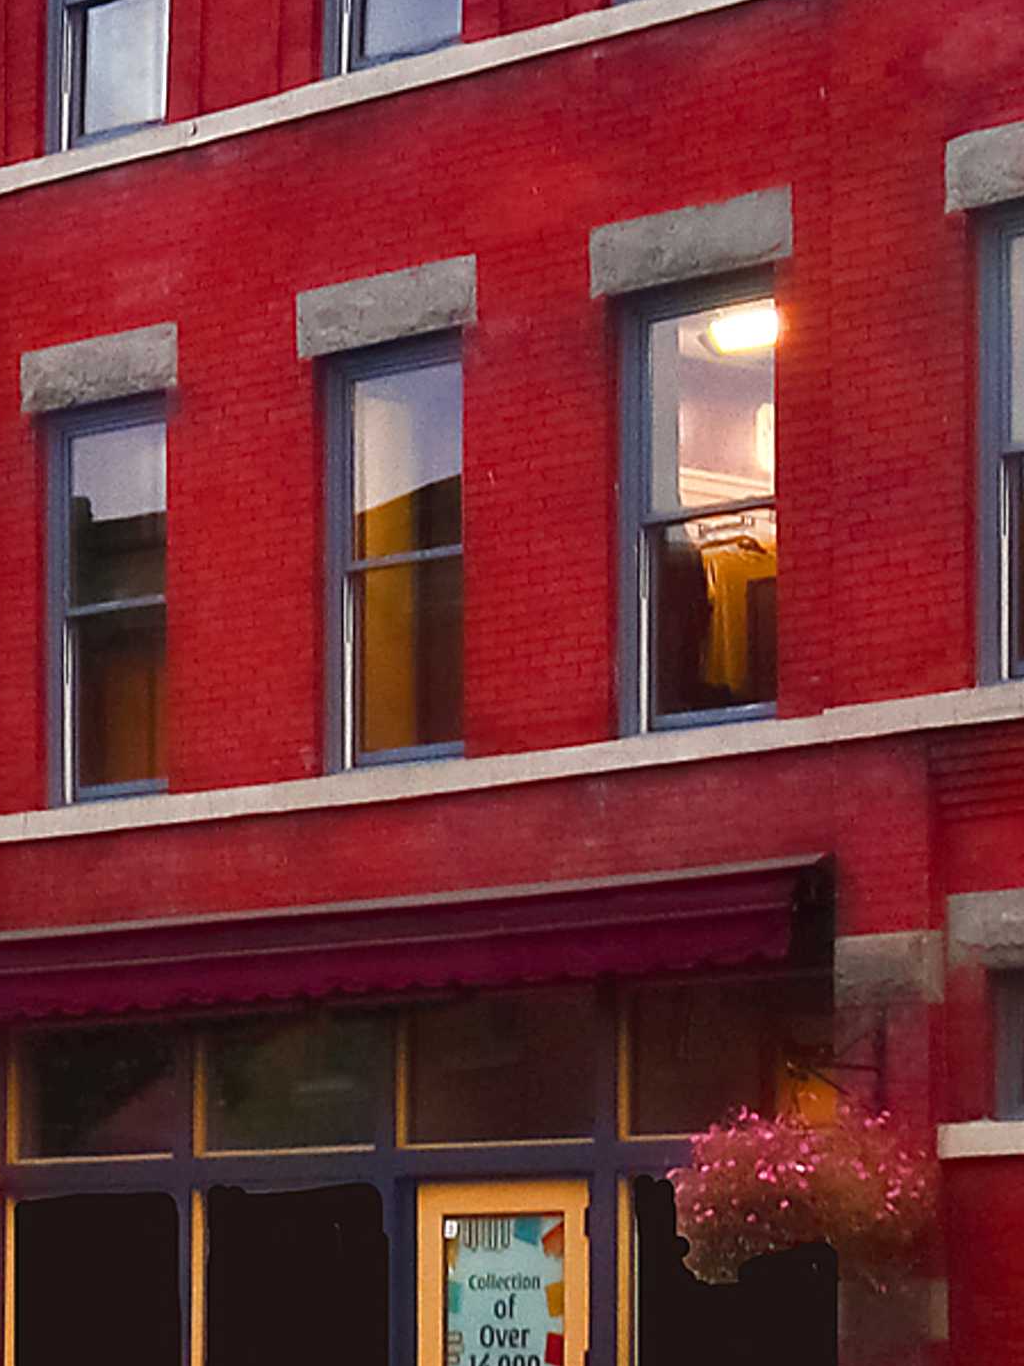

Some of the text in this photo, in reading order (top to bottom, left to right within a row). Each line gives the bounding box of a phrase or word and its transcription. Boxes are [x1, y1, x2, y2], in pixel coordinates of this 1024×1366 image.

[468, 1272, 540, 1291] Collection
[494, 1293, 516, 1319] of
[480, 1325, 530, 1348] Over
